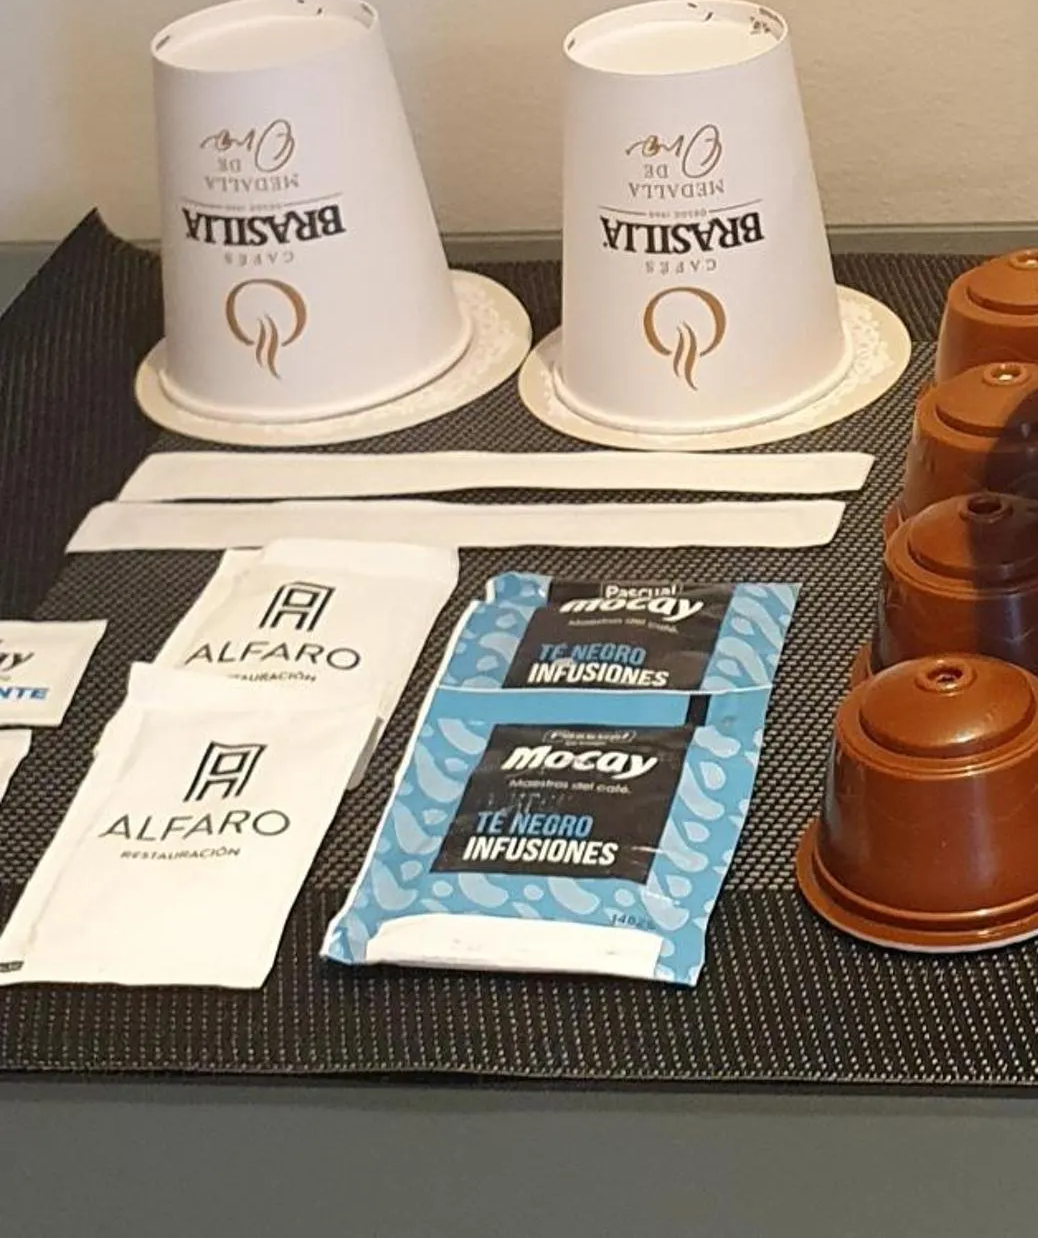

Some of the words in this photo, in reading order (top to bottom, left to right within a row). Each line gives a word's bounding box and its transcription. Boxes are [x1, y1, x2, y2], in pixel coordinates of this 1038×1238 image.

[625, 124, 722, 178] Oro
[204, 174, 299, 192] MEDALLA
[644, 164, 668, 178] DE
[629, 179, 724, 199] MEDALLA
[182, 205, 346, 246] BRASILIA
[600, 212, 765, 254] BRASILIA
[185, 641, 360, 670] ALFARO
[571, 643, 646, 666] NEGRO
[528, 662, 669, 688] INFUSIONES
[98, 810, 290, 841] ALFARO
[509, 812, 594, 838] NEGRO
[462, 836, 618, 866] INFUSIONES
